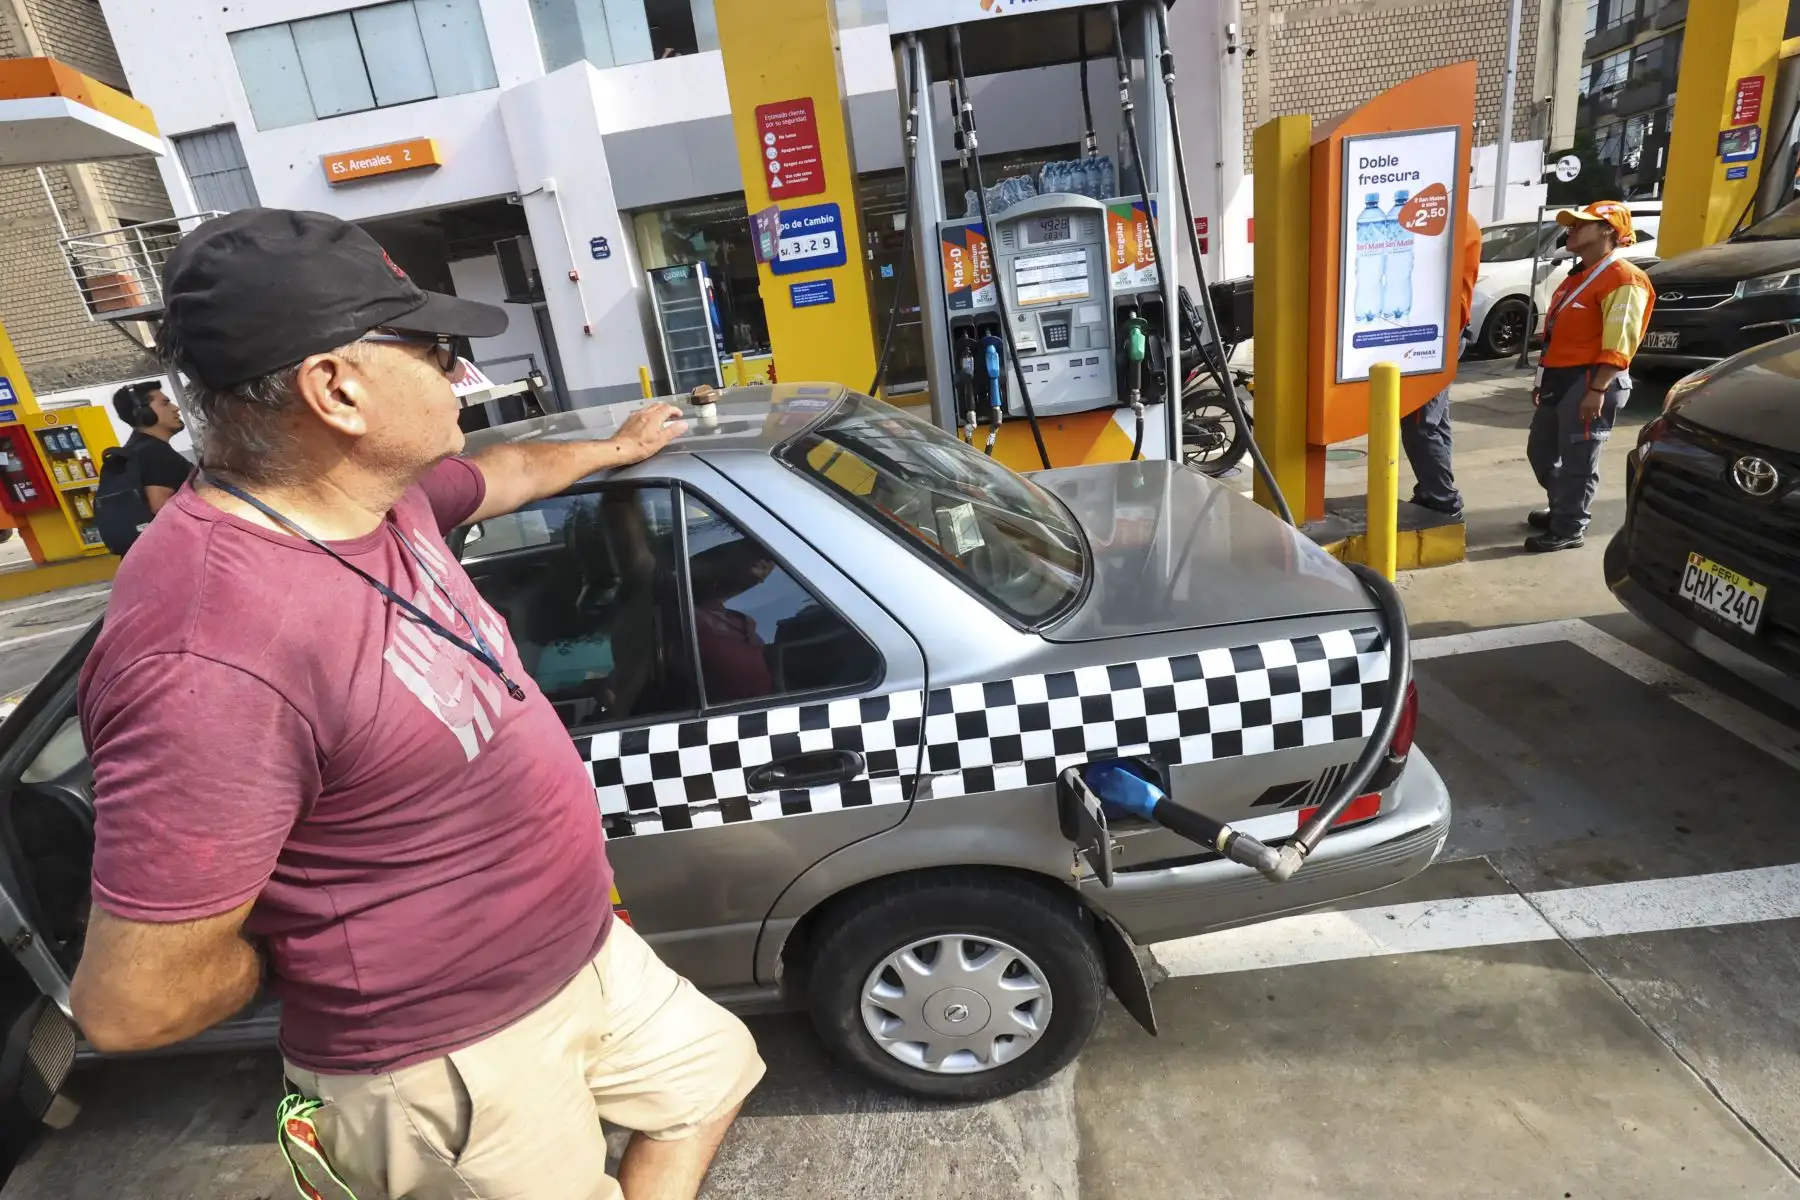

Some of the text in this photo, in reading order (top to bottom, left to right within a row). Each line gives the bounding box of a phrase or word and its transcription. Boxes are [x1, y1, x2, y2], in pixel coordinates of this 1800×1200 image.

[764, 112, 787, 121] Estimado
[332, 150, 411, 174] ES. Arenales 2
[1359, 155, 1399, 169] Doble
[1359, 171, 1420, 186] frescura
[804, 214, 834, 226] Cambio
[1116, 222, 1125, 264] G-Regular
[1136, 222, 1144, 262] G-Premium
[950, 248, 964, 288] Max-D
[972, 244, 980, 284] G-Premium
[979, 242, 992, 282] G-Prix
[1711, 564, 1739, 585] PERU
[1684, 565, 1759, 625] CHX-240
